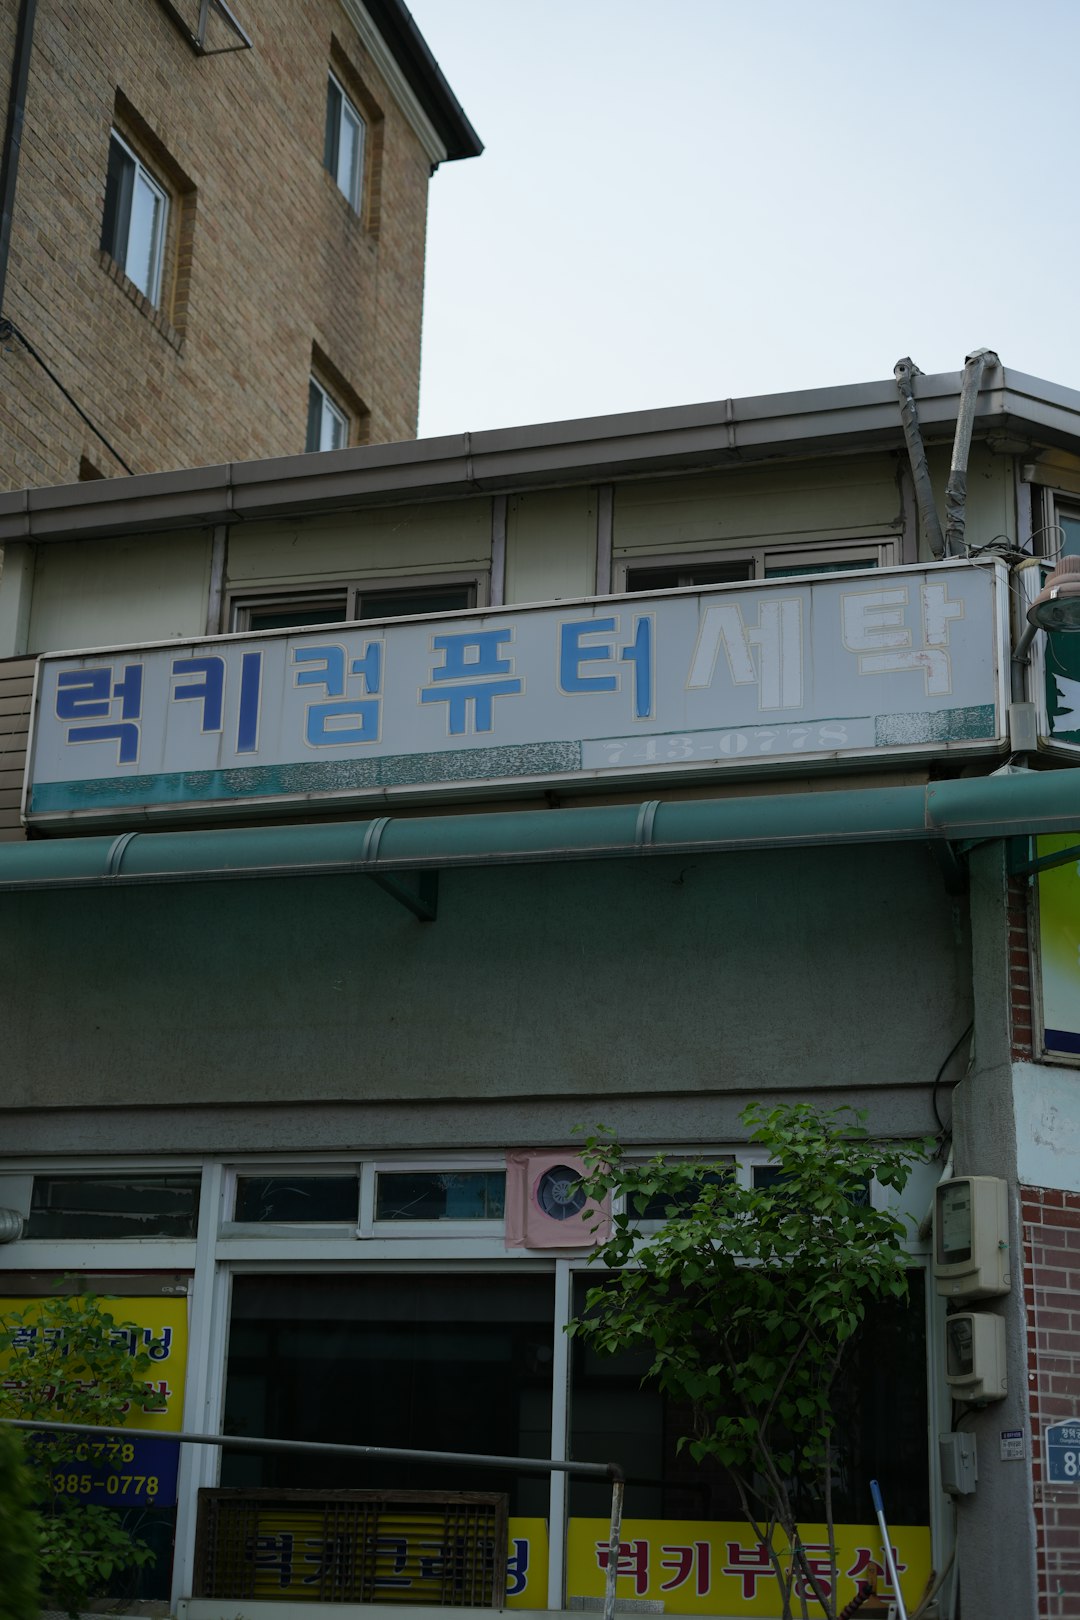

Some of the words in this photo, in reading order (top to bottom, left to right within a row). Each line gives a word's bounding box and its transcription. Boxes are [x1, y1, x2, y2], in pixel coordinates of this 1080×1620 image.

[601, 724, 849, 764] 743-0778
[1064, 1451, 1080, 1477] 8
[595, 1540, 909, 1603] 럭키부동산
